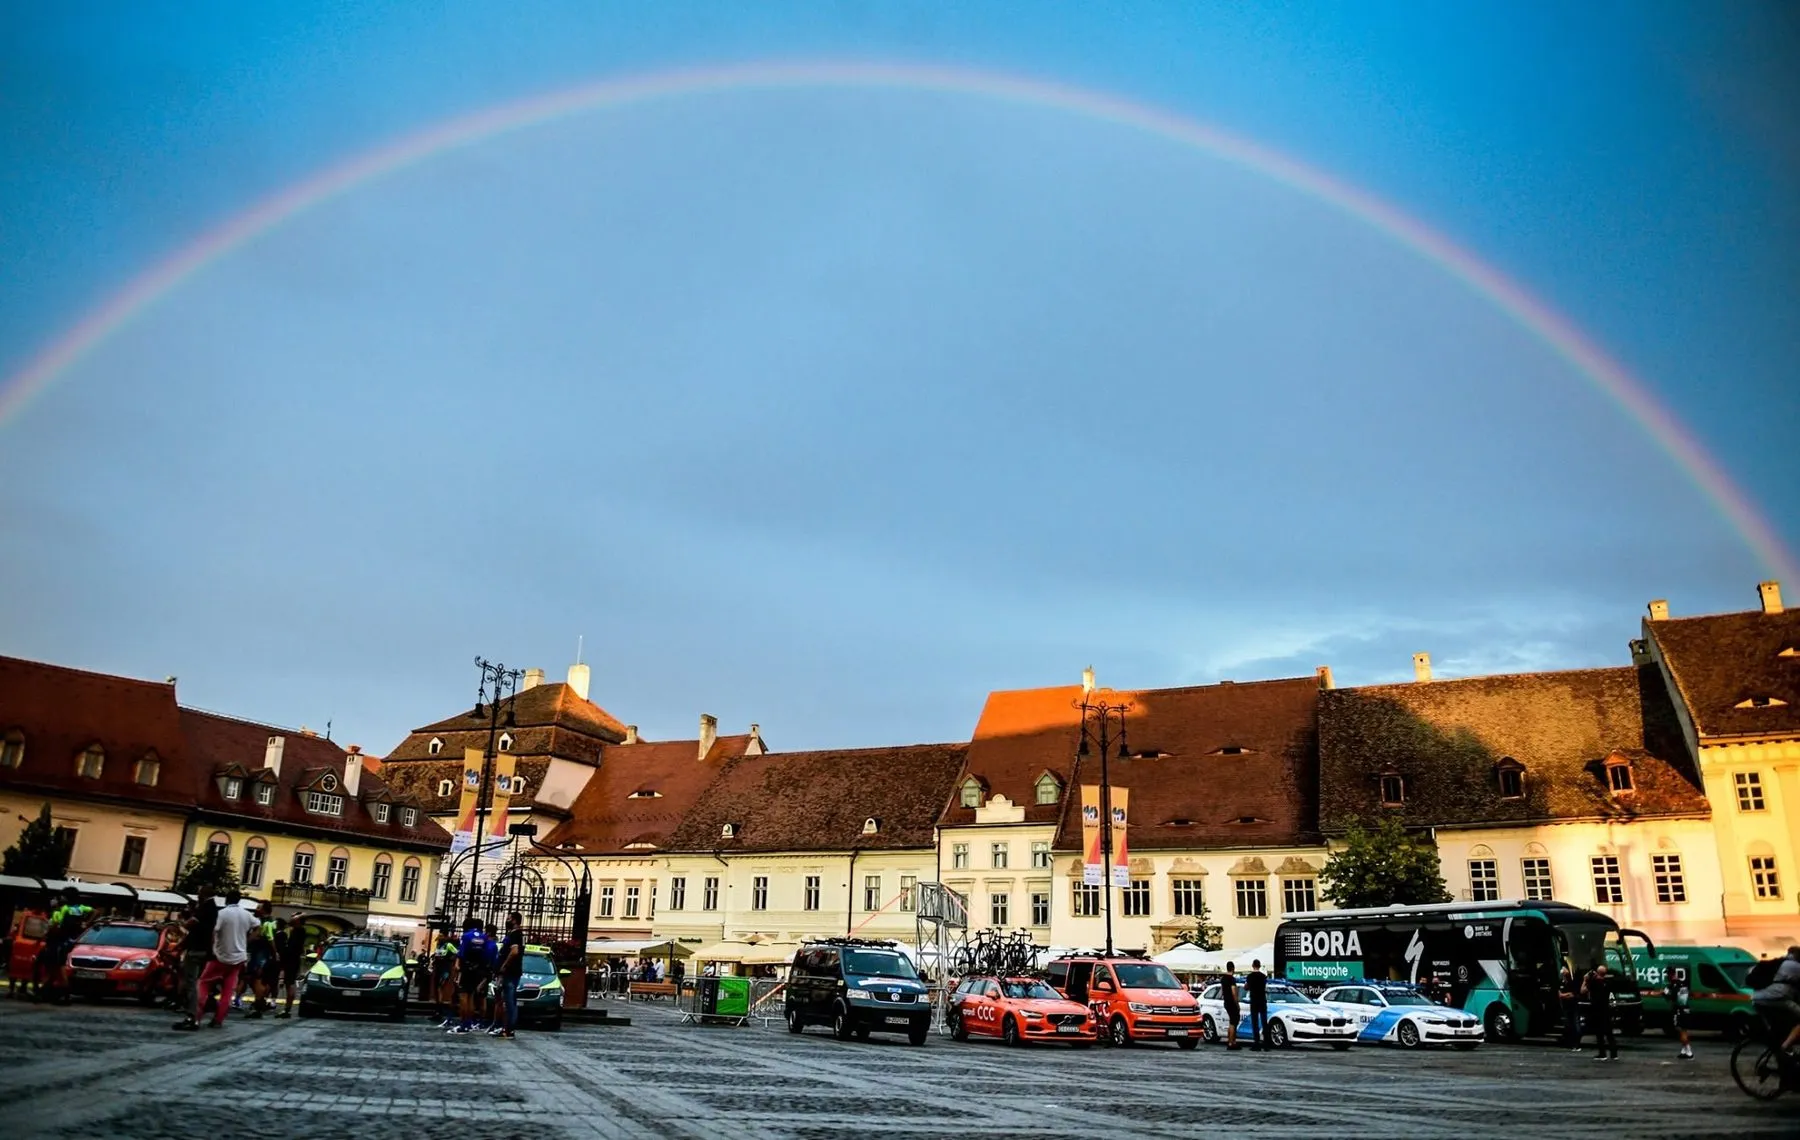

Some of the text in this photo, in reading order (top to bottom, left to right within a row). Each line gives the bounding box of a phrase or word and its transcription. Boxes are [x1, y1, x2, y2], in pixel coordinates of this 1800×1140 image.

[1300, 930, 1363, 957] BORA
[1301, 961, 1349, 979] hansgrohe
[977, 1005, 995, 1021] CCC
